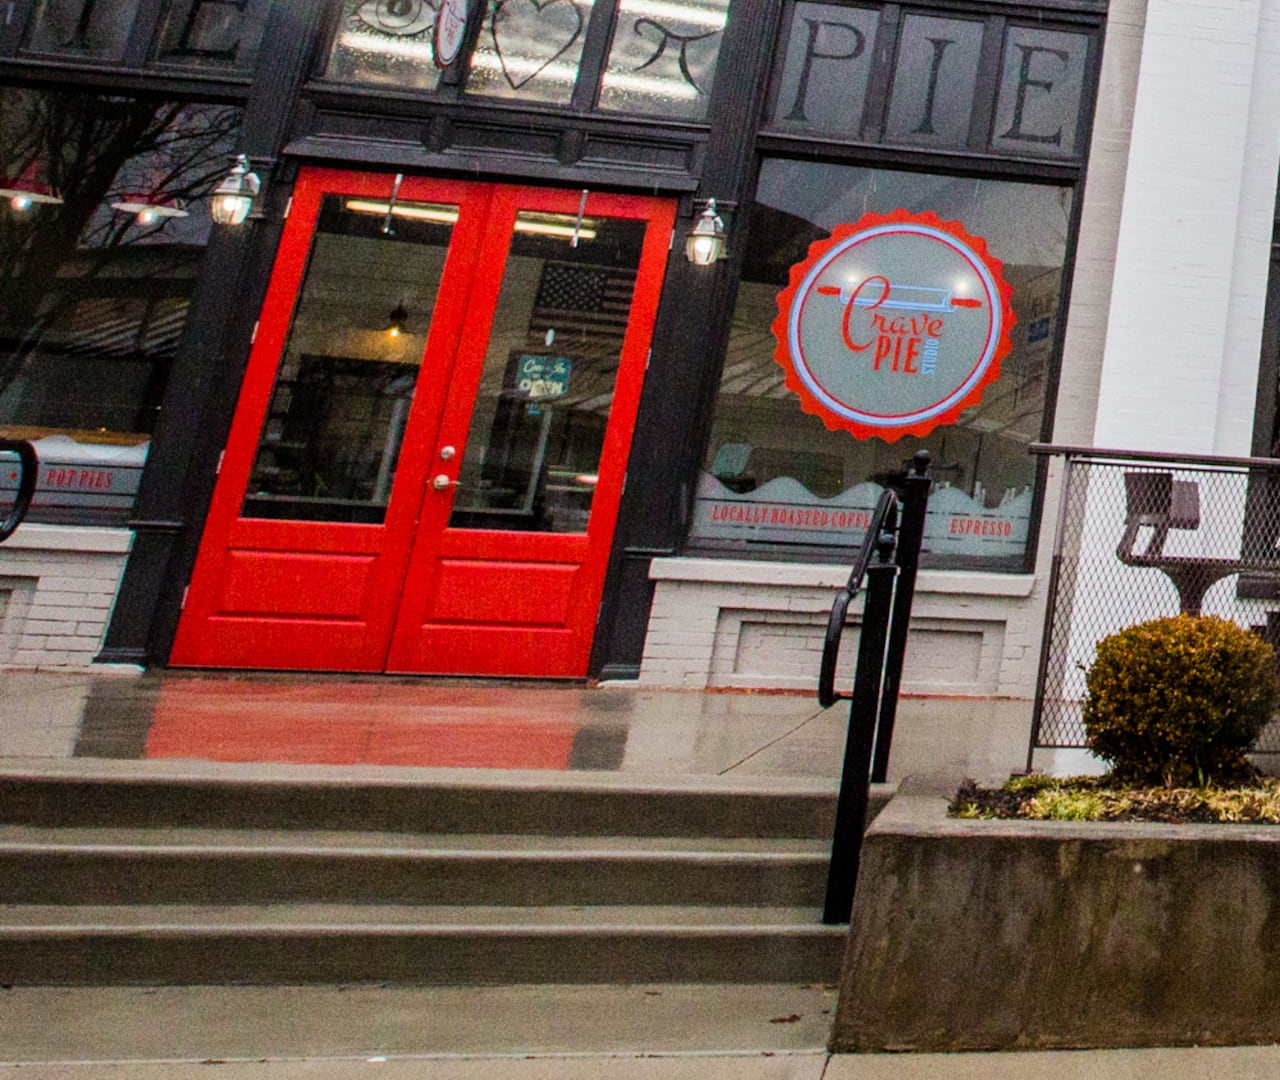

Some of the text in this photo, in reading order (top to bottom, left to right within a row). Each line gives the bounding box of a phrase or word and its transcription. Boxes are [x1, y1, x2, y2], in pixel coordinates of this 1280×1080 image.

[783, 17, 1070, 147] PIE
[841, 275, 945, 352] Crave
[873, 335, 922, 375] PIE
[921, 338, 940, 376] STUDIO
[46, 469, 114, 489] POT PIES
[712, 504, 870, 530] LOCALLY ROASTED COFFE
[950, 518, 1012, 537] ESPRESSO
